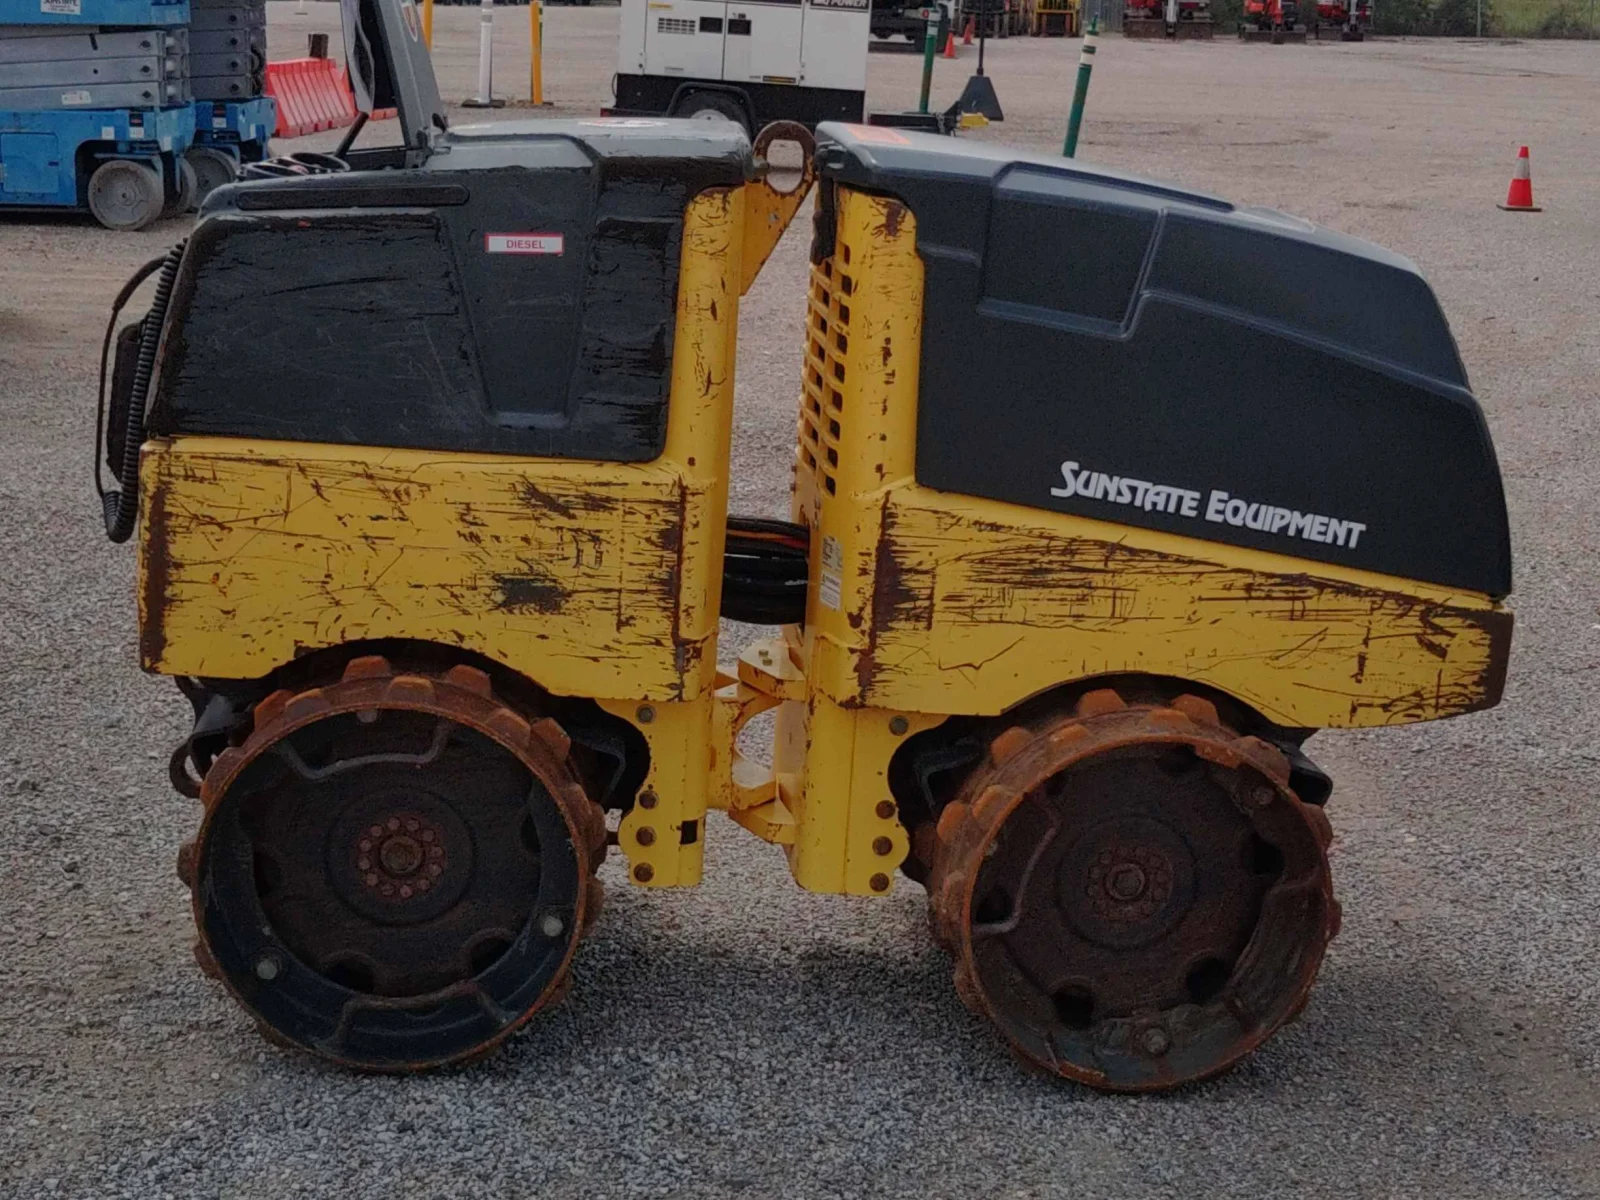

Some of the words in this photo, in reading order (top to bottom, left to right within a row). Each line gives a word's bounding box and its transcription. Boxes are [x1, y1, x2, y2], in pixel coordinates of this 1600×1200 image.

[506, 239, 545, 249] DIESEL
[1050, 461, 1200, 516] SUNSTATE
[1205, 489, 1366, 548] EQUIPMENT
